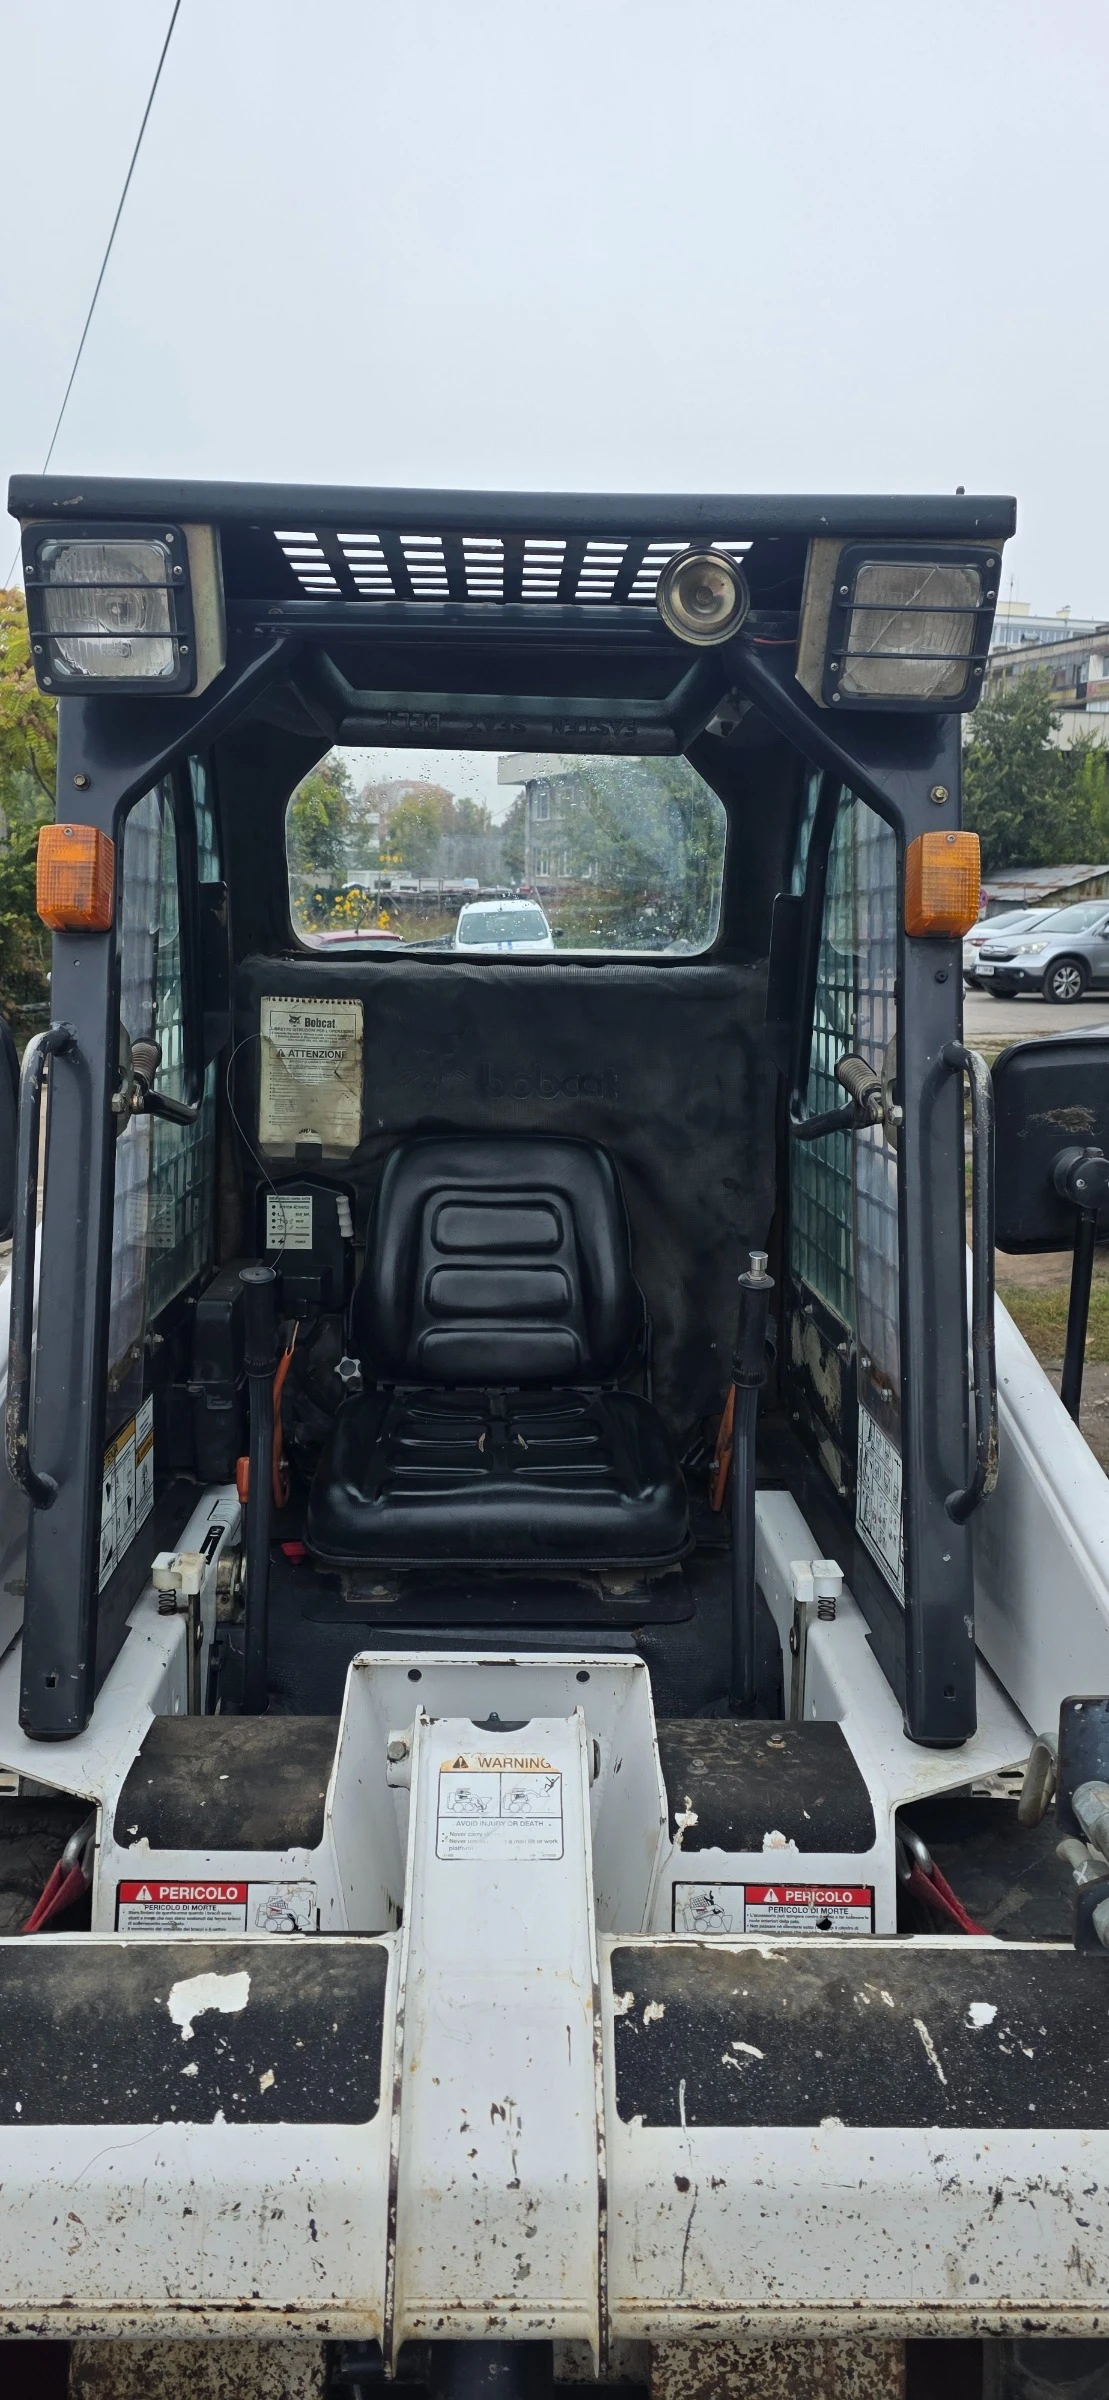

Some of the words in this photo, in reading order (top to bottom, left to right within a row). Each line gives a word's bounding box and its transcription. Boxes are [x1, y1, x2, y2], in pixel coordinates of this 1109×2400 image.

[383, 711, 441, 732] BELT
[465, 717, 528, 736] SEAT
[551, 717, 638, 737] FASTEN
[305, 1017, 336, 1028] Bobcat
[287, 1049, 347, 1058] ATTENZIONE
[478, 1757, 552, 1769] WARNING
[159, 1886, 238, 1900] PERICOLO
[785, 1890, 853, 1903] PERICOLO
[768, 1906, 809, 1914] PERICOLO
[820, 1907, 849, 1915] MORTE
